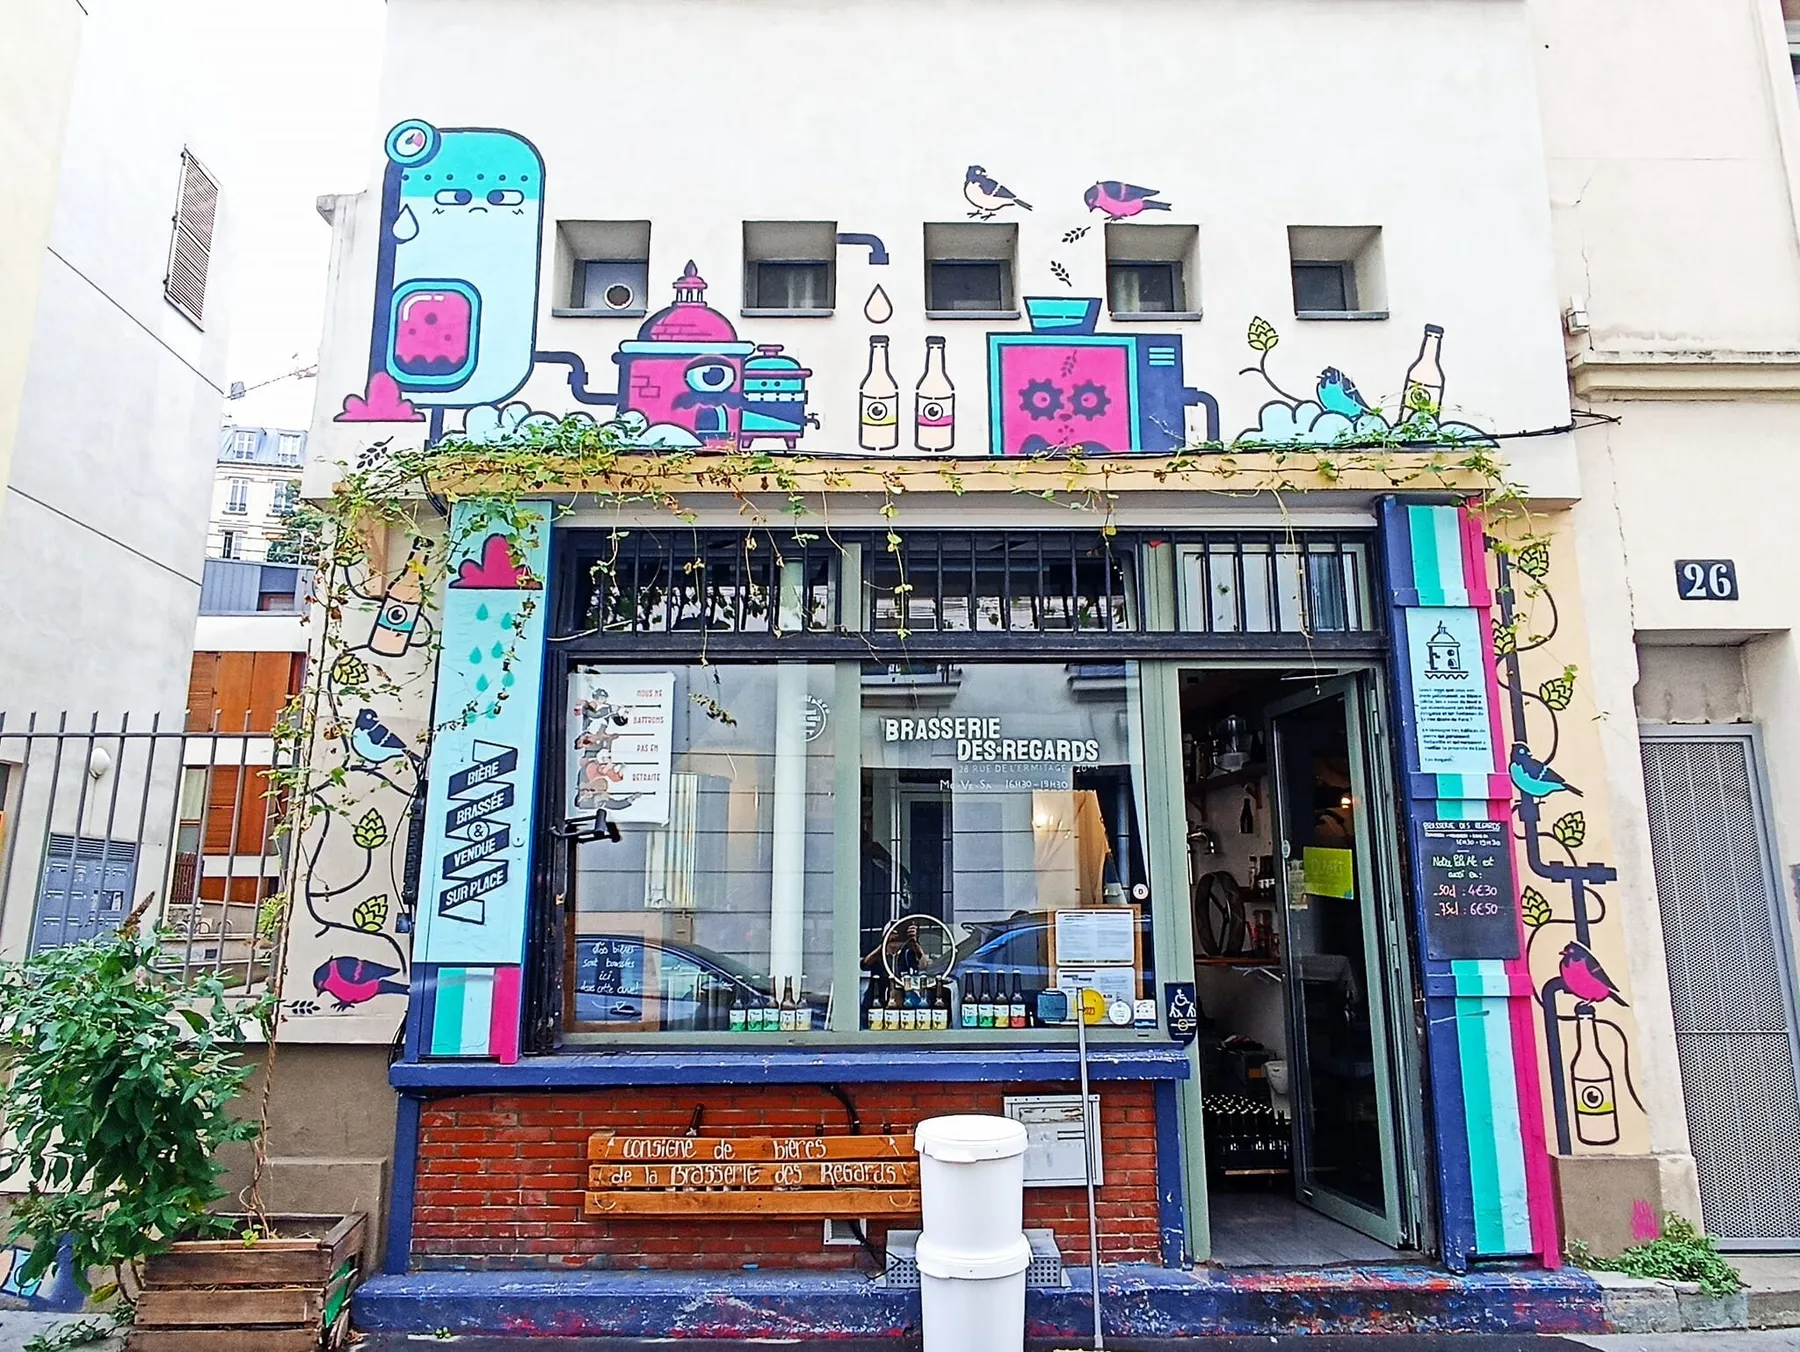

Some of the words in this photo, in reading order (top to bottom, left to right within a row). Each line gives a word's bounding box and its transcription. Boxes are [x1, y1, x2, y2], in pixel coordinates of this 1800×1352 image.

[1683, 563, 1732, 597] 26
[885, 716, 1001, 742] BRASSERIE
[637, 744, 648, 752] PAS
[466, 760, 499, 786] BIÈRE
[972, 764, 991, 773] RUE
[995, 764, 1007, 773] DE
[1009, 764, 1067, 773] L'ERMITAGE
[456, 790, 505, 825] BRASSÉE
[473, 823, 484, 838] &
[453, 837, 496, 867] VENDUE
[445, 884, 469, 906] SUR
[469, 869, 504, 898] PLACE
[1467, 884, 1498, 897] 4€30
[1469, 902, 1498, 916] 6€50
[713, 1139, 737, 1161] de
[610, 1165, 633, 1184] de
[644, 1165, 658, 1185] la
[670, 1164, 759, 1186] Brasserie
[774, 1163, 802, 1184] des
